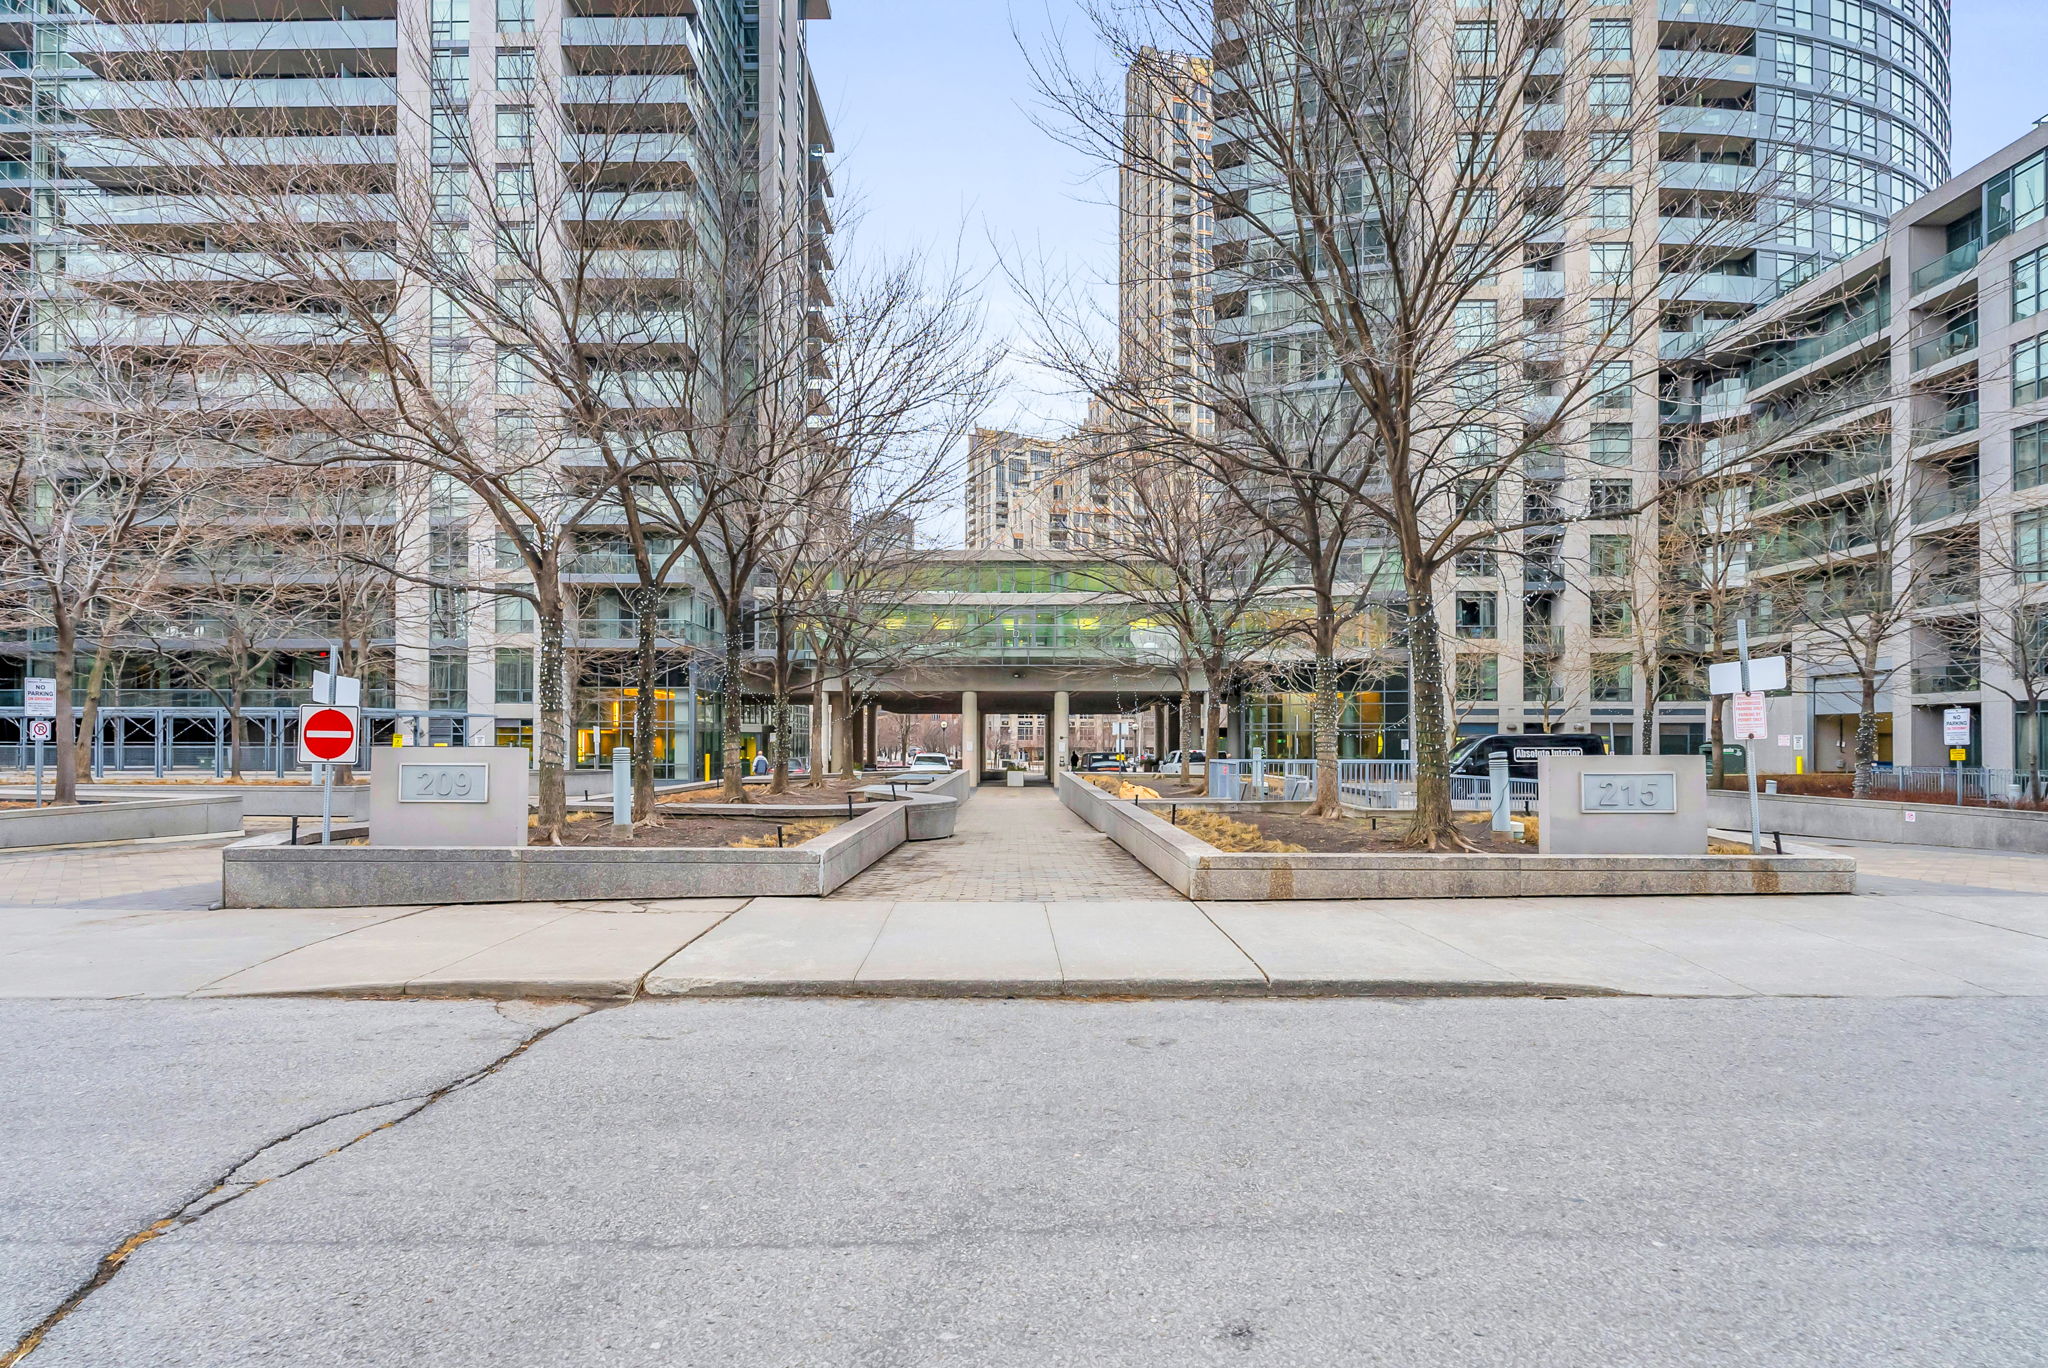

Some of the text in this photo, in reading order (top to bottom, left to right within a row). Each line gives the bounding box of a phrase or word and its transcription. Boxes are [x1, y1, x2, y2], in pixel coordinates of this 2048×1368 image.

[1516, 749, 1550, 758] Absolute
[416, 771, 472, 797] 209
[1599, 781, 1659, 807] 215
